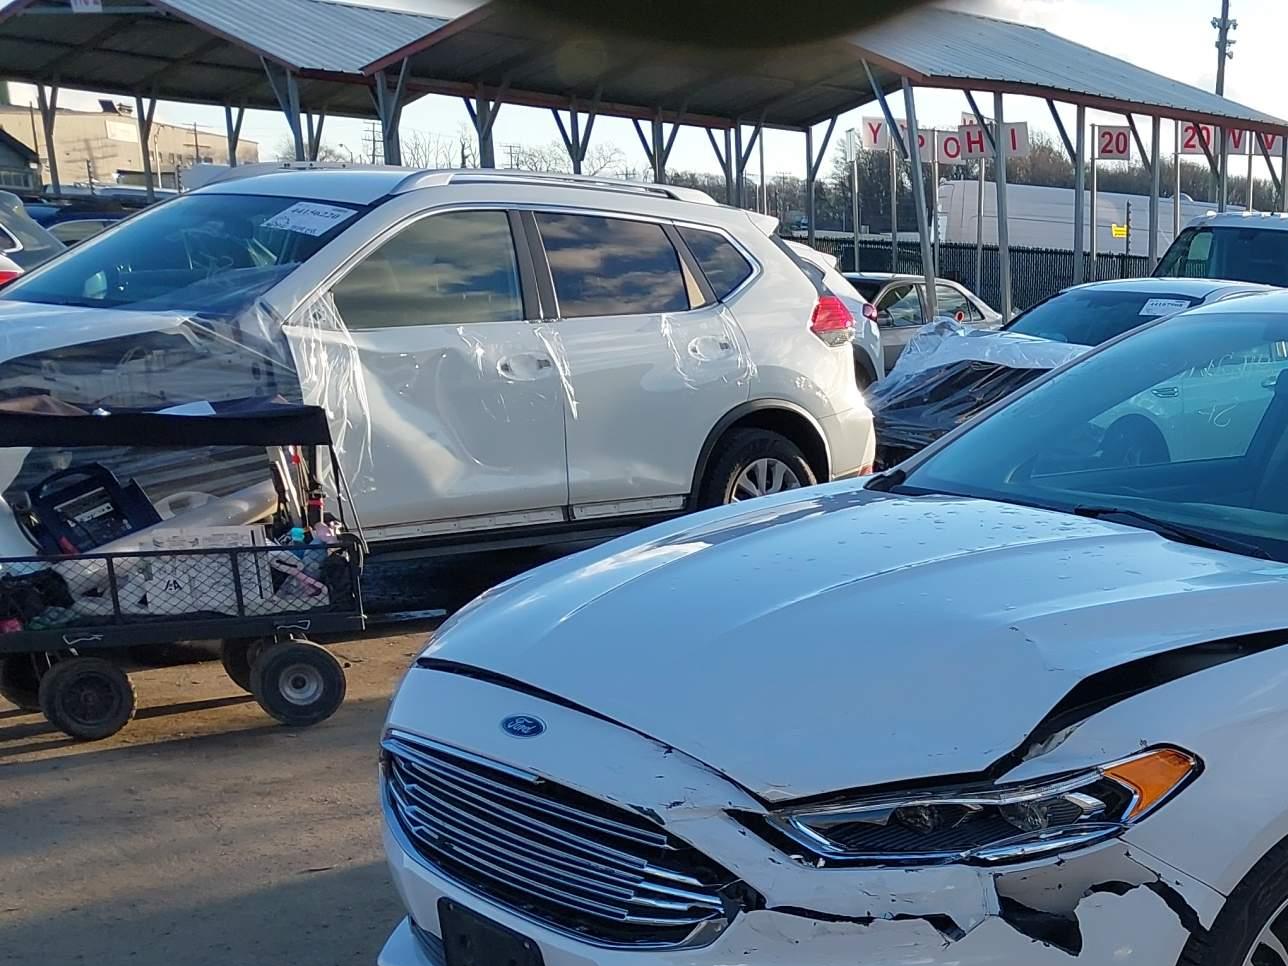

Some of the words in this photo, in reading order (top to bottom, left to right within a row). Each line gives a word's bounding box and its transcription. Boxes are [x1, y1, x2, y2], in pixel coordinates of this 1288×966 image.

[868, 122, 882, 144] Y
[966, 131, 984, 153] H
[1101, 131, 1128, 154] 20
[1184, 125, 1211, 149] 20
[944, 137, 960, 158] O
[507, 718, 537, 734] Ford
